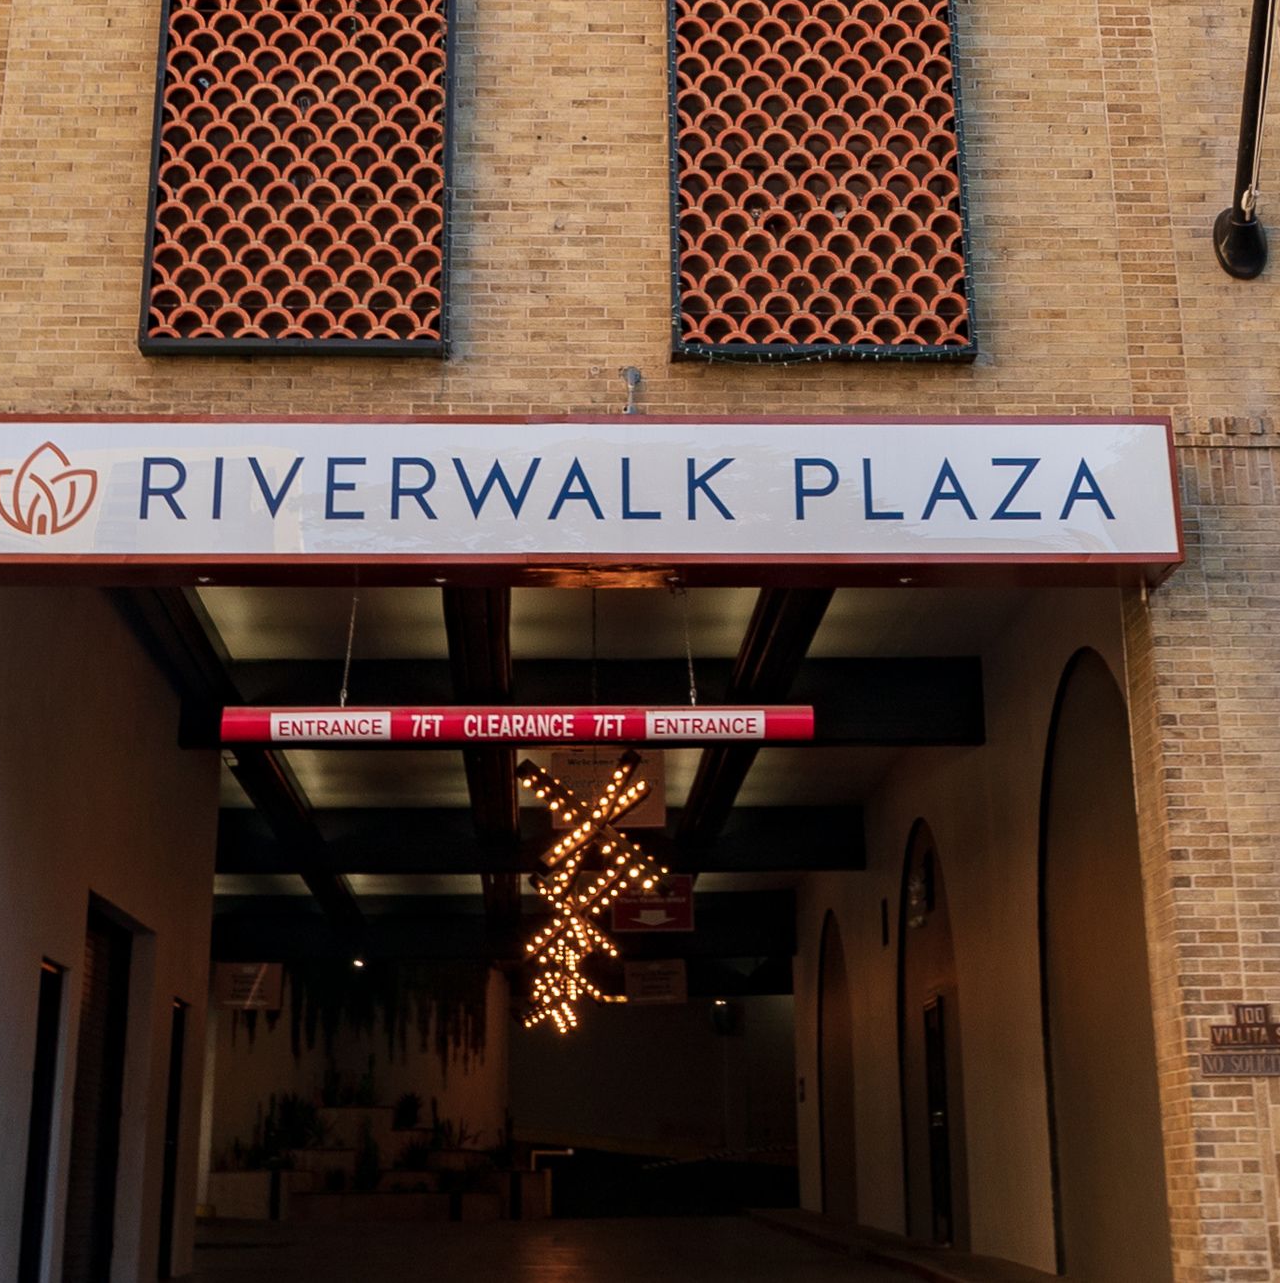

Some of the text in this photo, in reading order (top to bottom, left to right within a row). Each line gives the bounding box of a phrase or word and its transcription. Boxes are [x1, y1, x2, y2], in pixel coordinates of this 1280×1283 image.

[139, 457, 1116, 520] RIVERWALK PLAZA
[278, 719, 384, 736] ENTRANCE
[411, 714, 625, 737] 7FT CLEARANCE 7FT
[654, 718, 757, 734] ENTRANCE
[1239, 1007, 1266, 1024] 100
[1213, 1027, 1269, 1044] VILLITA
[1204, 1055, 1224, 1073] NO
